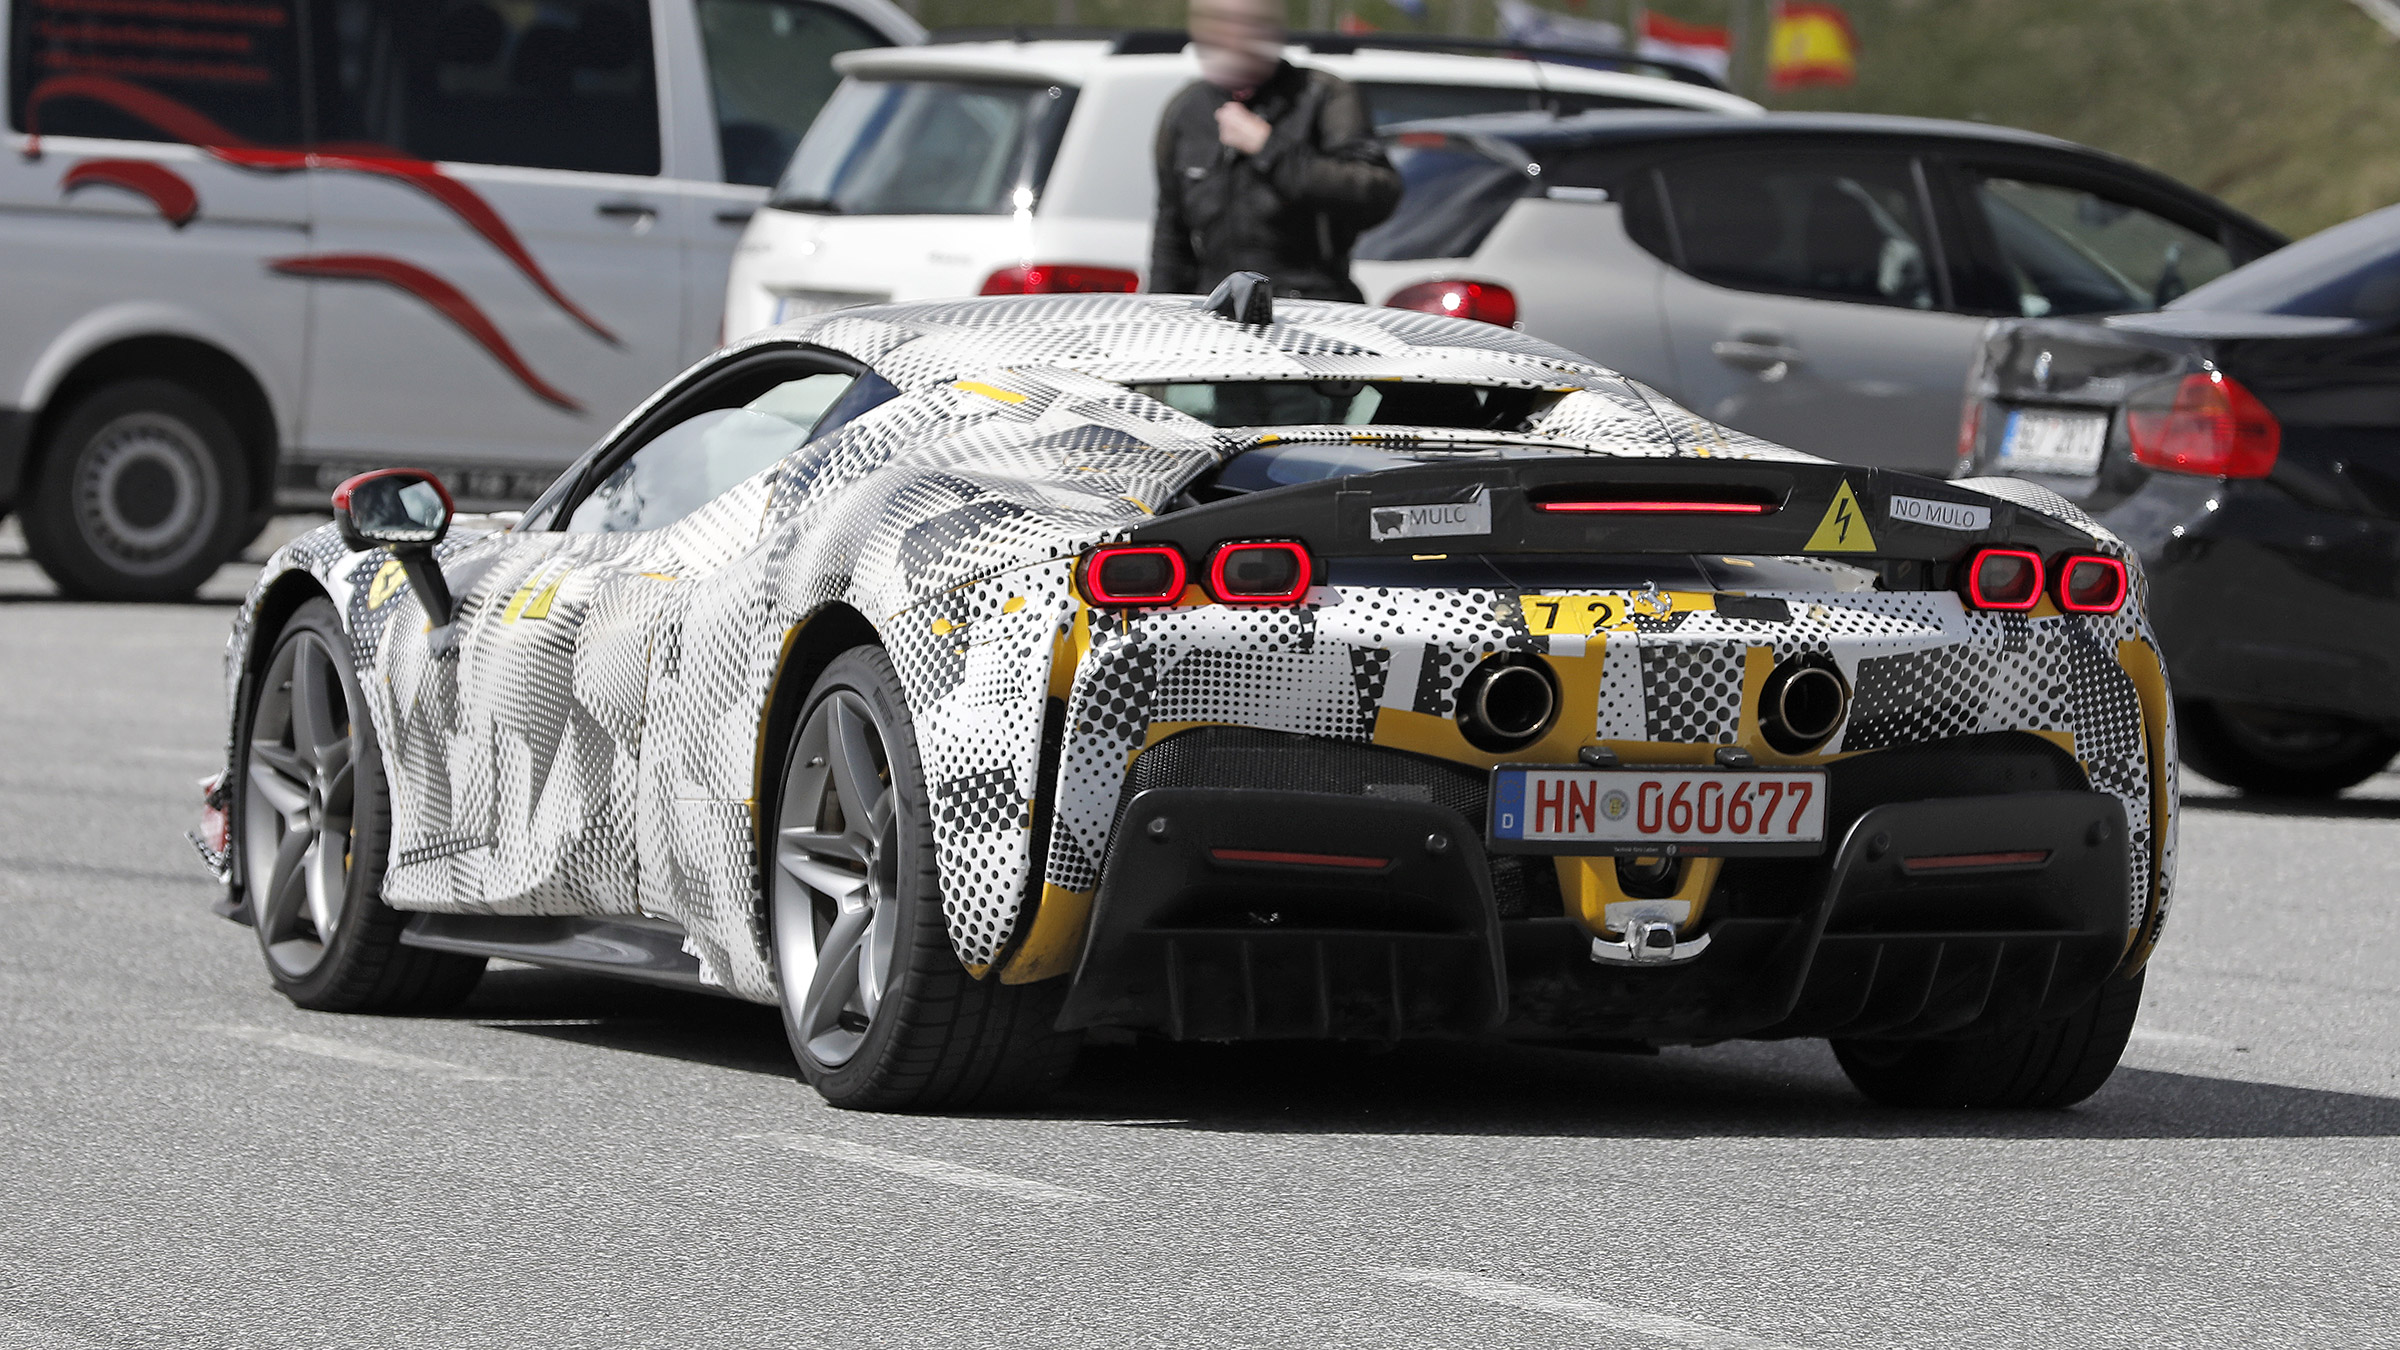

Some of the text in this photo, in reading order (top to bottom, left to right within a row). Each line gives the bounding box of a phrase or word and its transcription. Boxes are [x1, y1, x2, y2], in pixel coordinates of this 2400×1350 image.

[1895, 499, 1975, 527] NO MULO
[1502, 779, 1813, 835] D HN 060677
